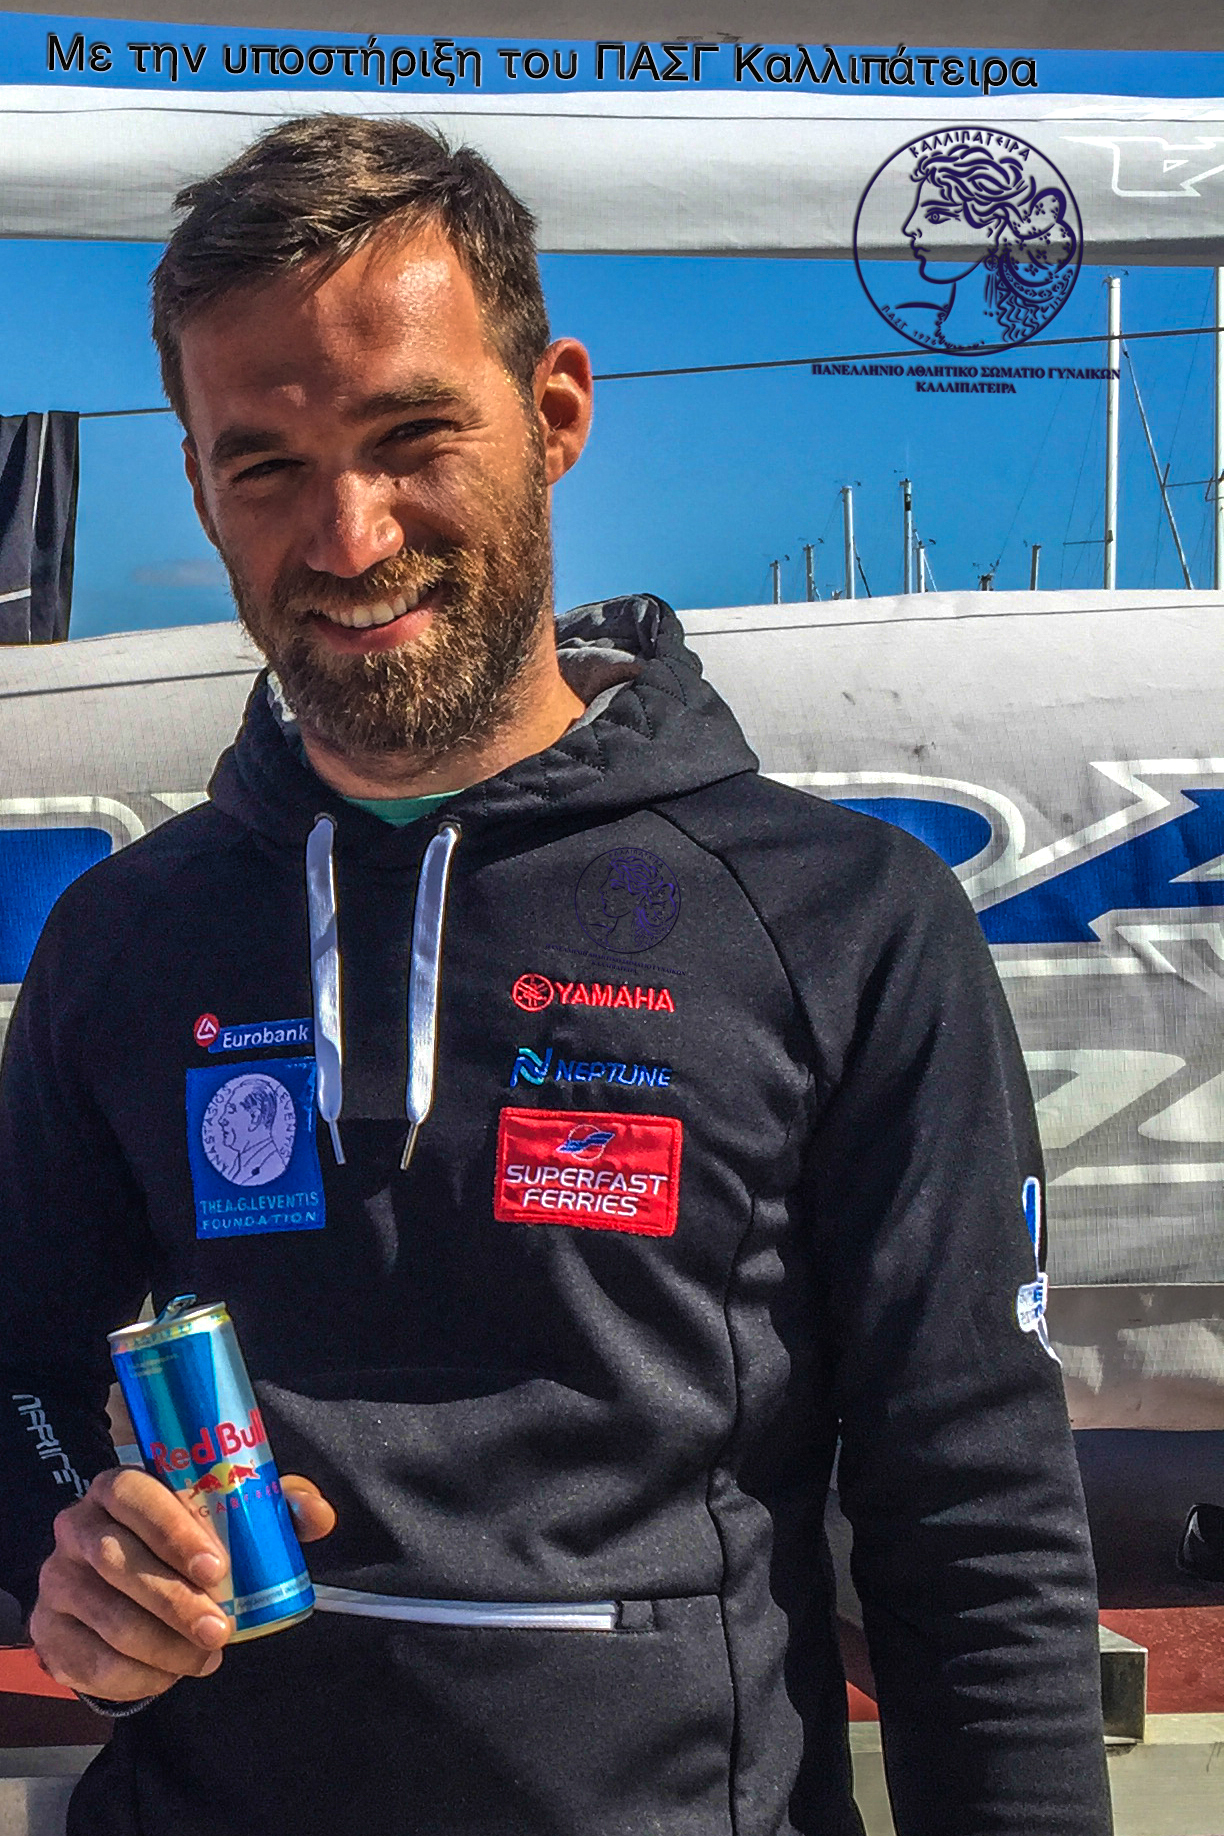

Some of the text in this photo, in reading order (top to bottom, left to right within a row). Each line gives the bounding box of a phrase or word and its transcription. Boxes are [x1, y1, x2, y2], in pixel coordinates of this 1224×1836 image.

[556, 980, 675, 1013] YAMAHA
[222, 1024, 309, 1048] Eurobank
[554, 1059, 673, 1087] NEPTUNE
[504, 1164, 668, 1196] SUPERFAST
[200, 1199, 225, 1215] THE
[251, 1192, 319, 1211] LEVENTIS
[523, 1189, 639, 1217] FERRIES
[202, 1212, 317, 1230] FOUNDATION
[150, 1408, 266, 1474] Red Bull
